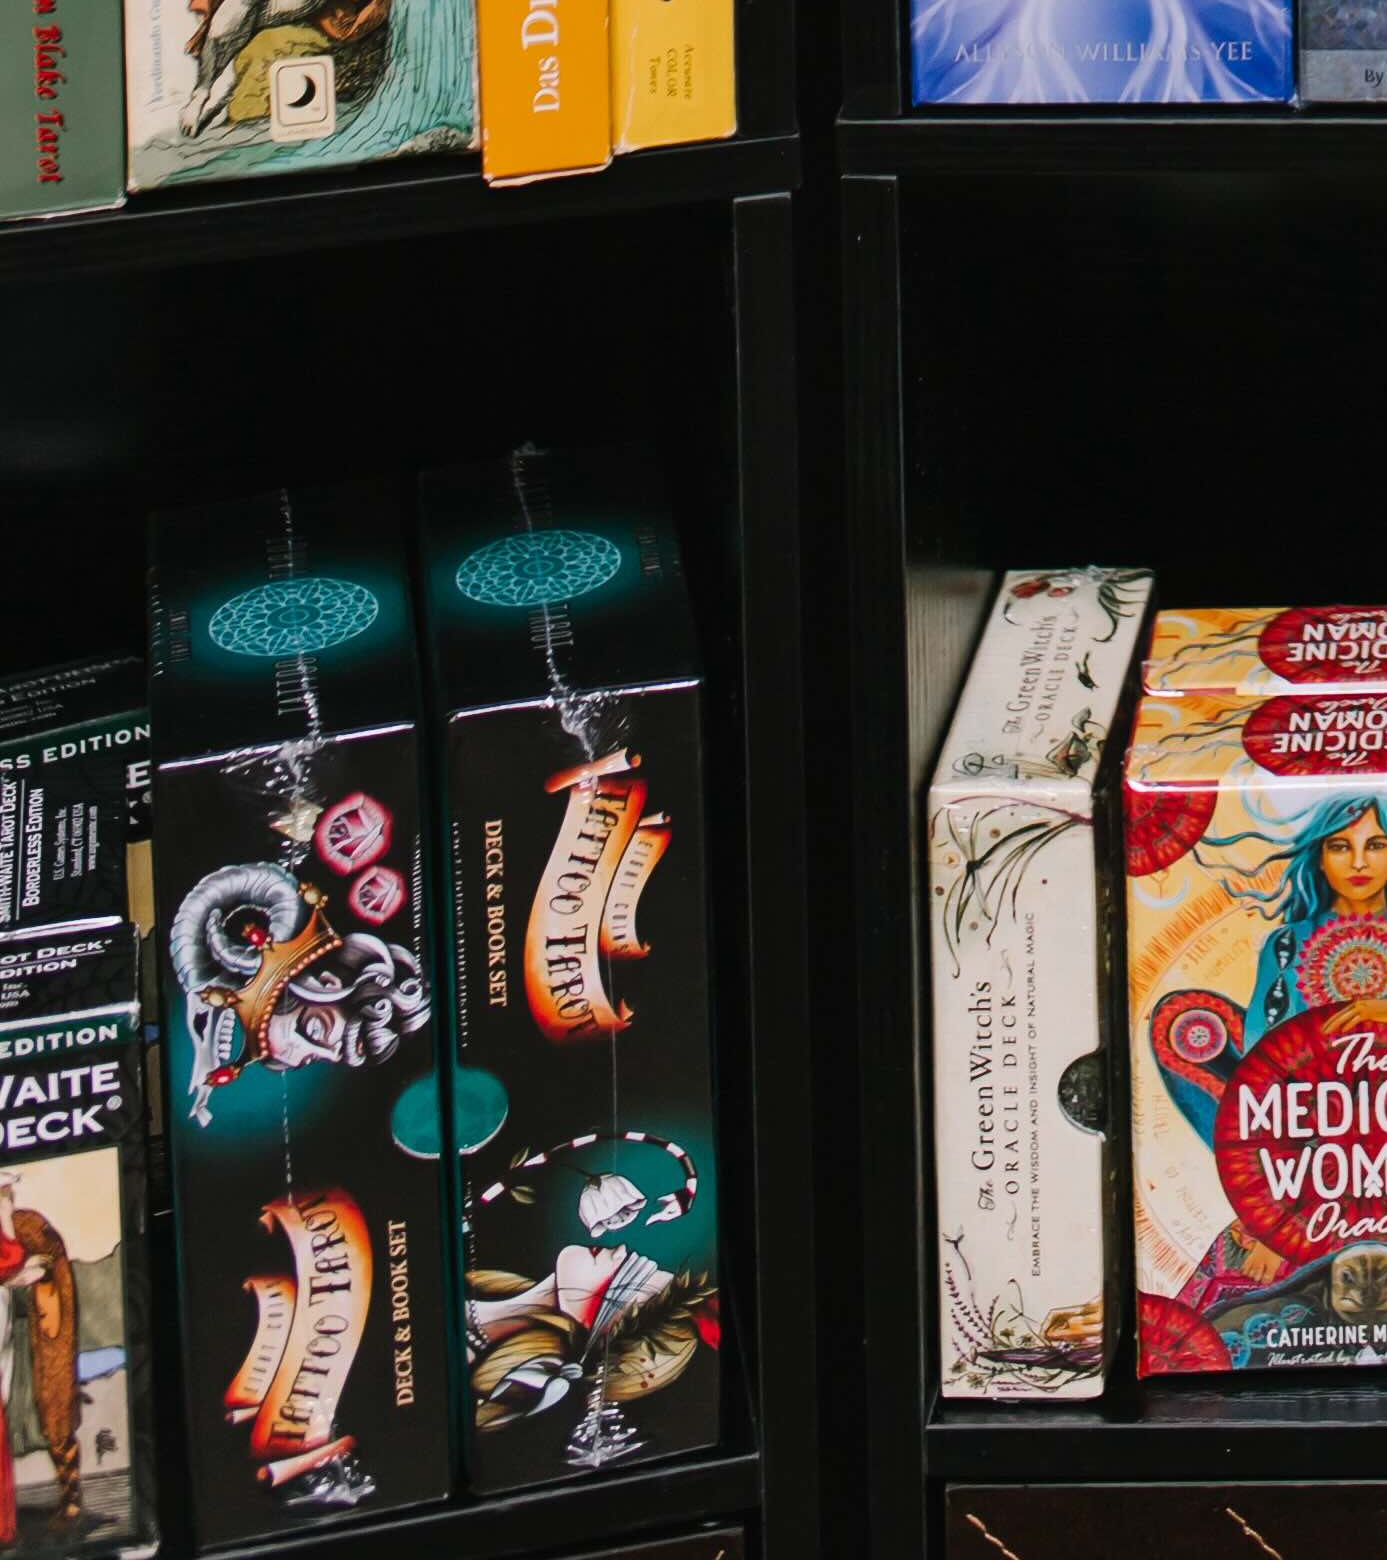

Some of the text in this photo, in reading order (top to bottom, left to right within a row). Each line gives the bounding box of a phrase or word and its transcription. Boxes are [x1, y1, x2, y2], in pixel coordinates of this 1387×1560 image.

[533, 57, 561, 114] Das
[485, 820, 509, 1008] DECK & BOOK SET
[1267, 1324, 1369, 1347] CATHERINE
